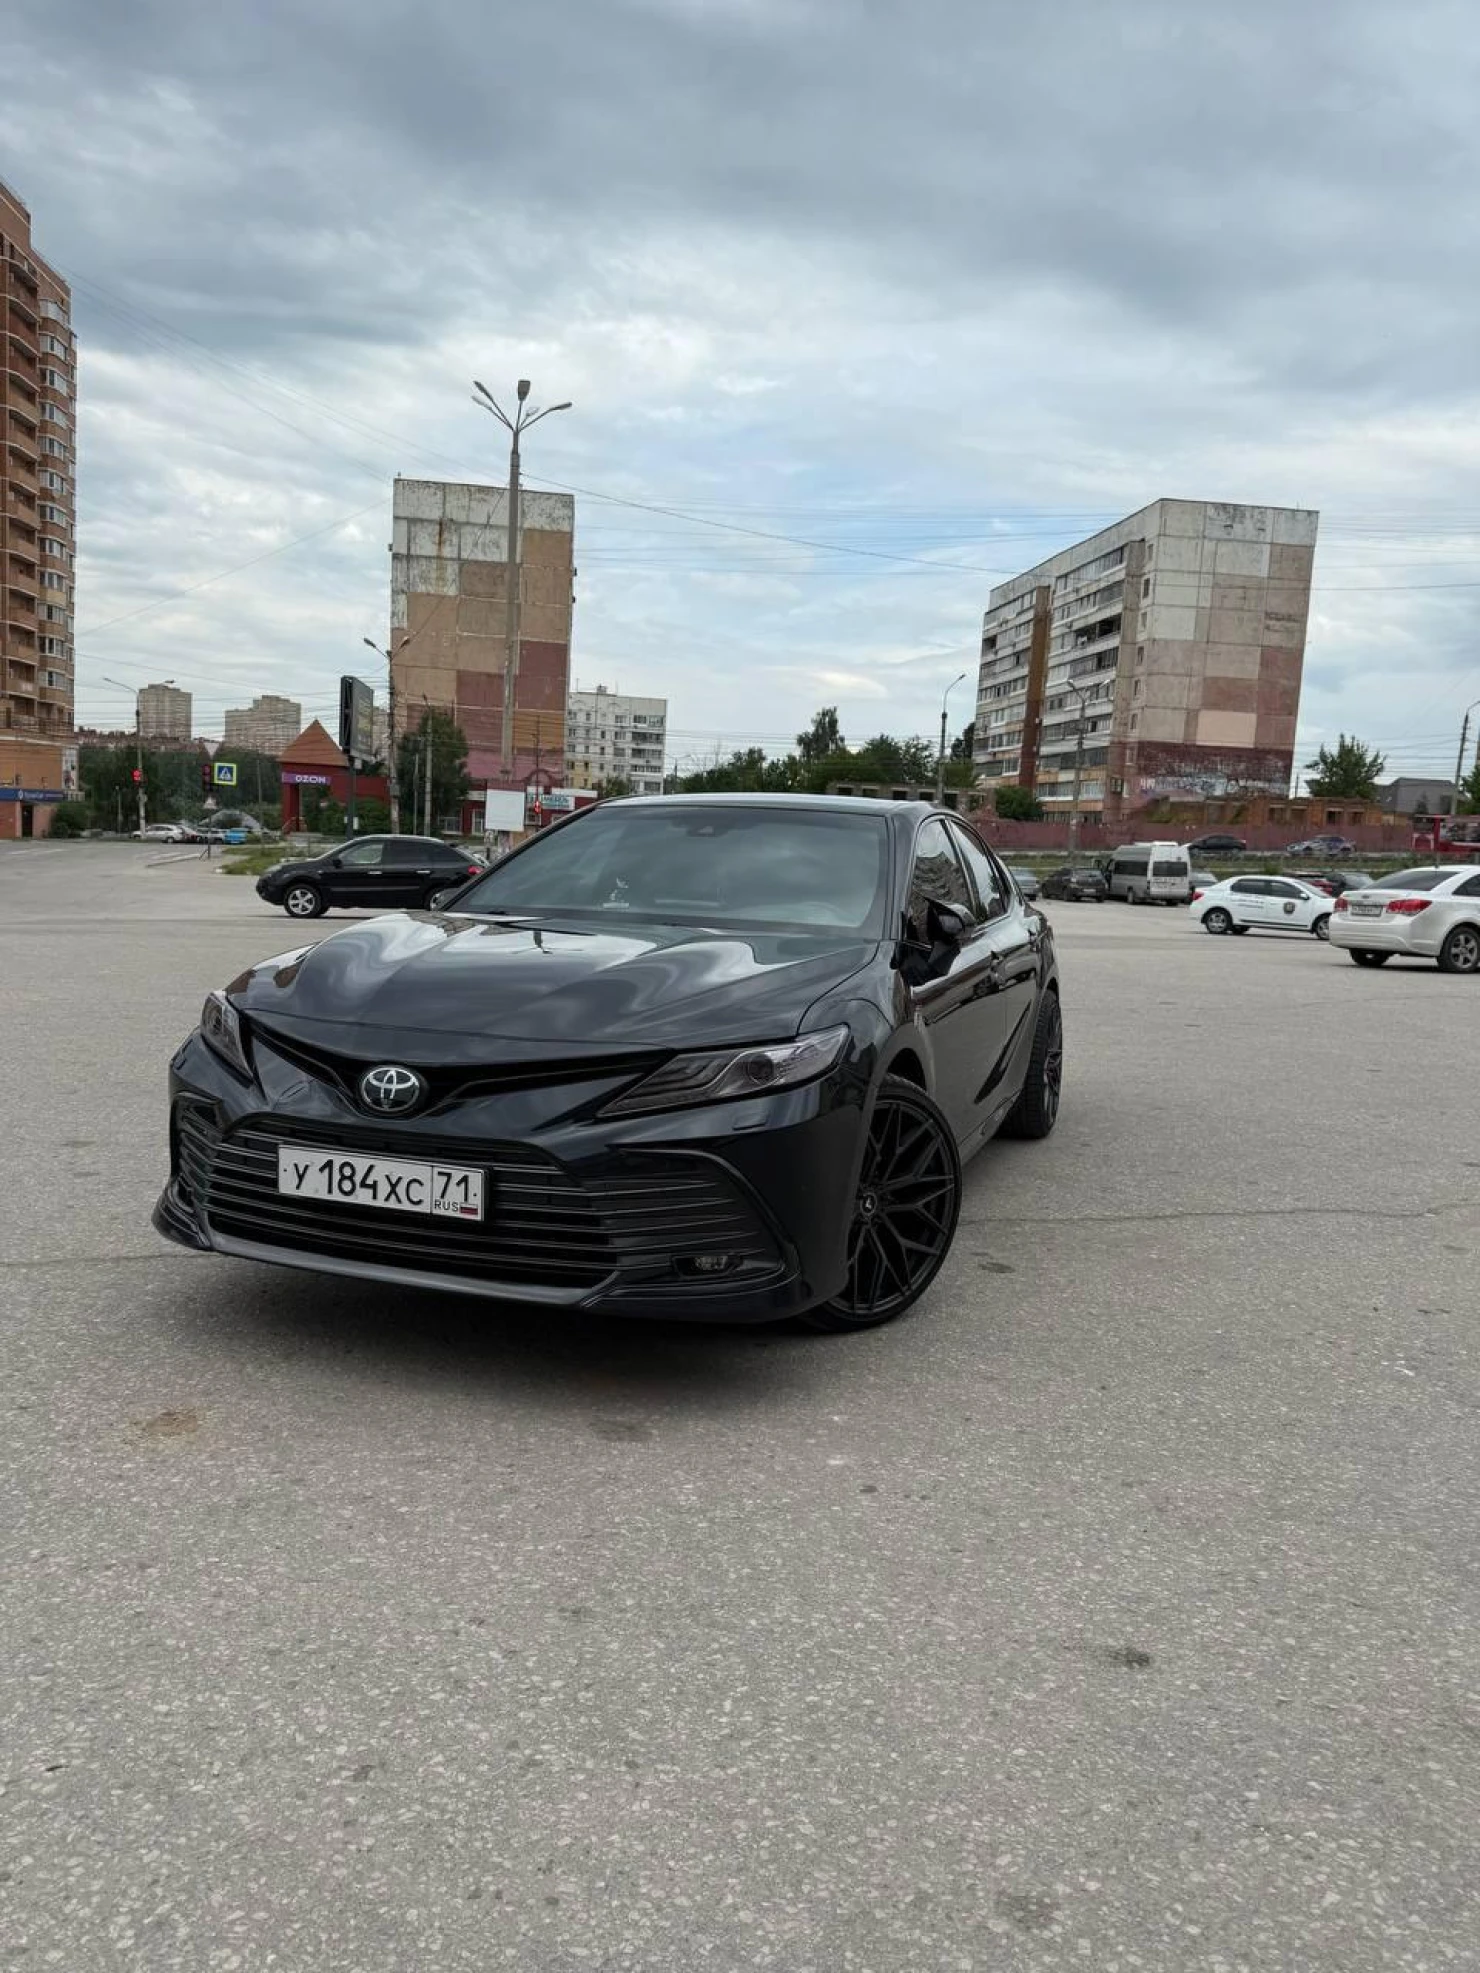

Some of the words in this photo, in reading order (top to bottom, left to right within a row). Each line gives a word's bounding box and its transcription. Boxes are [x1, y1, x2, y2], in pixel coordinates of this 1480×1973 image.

[295, 774, 326, 784] OZON
[437, 1171, 469, 1202] 71
[434, 1199, 459, 1212] RUS
